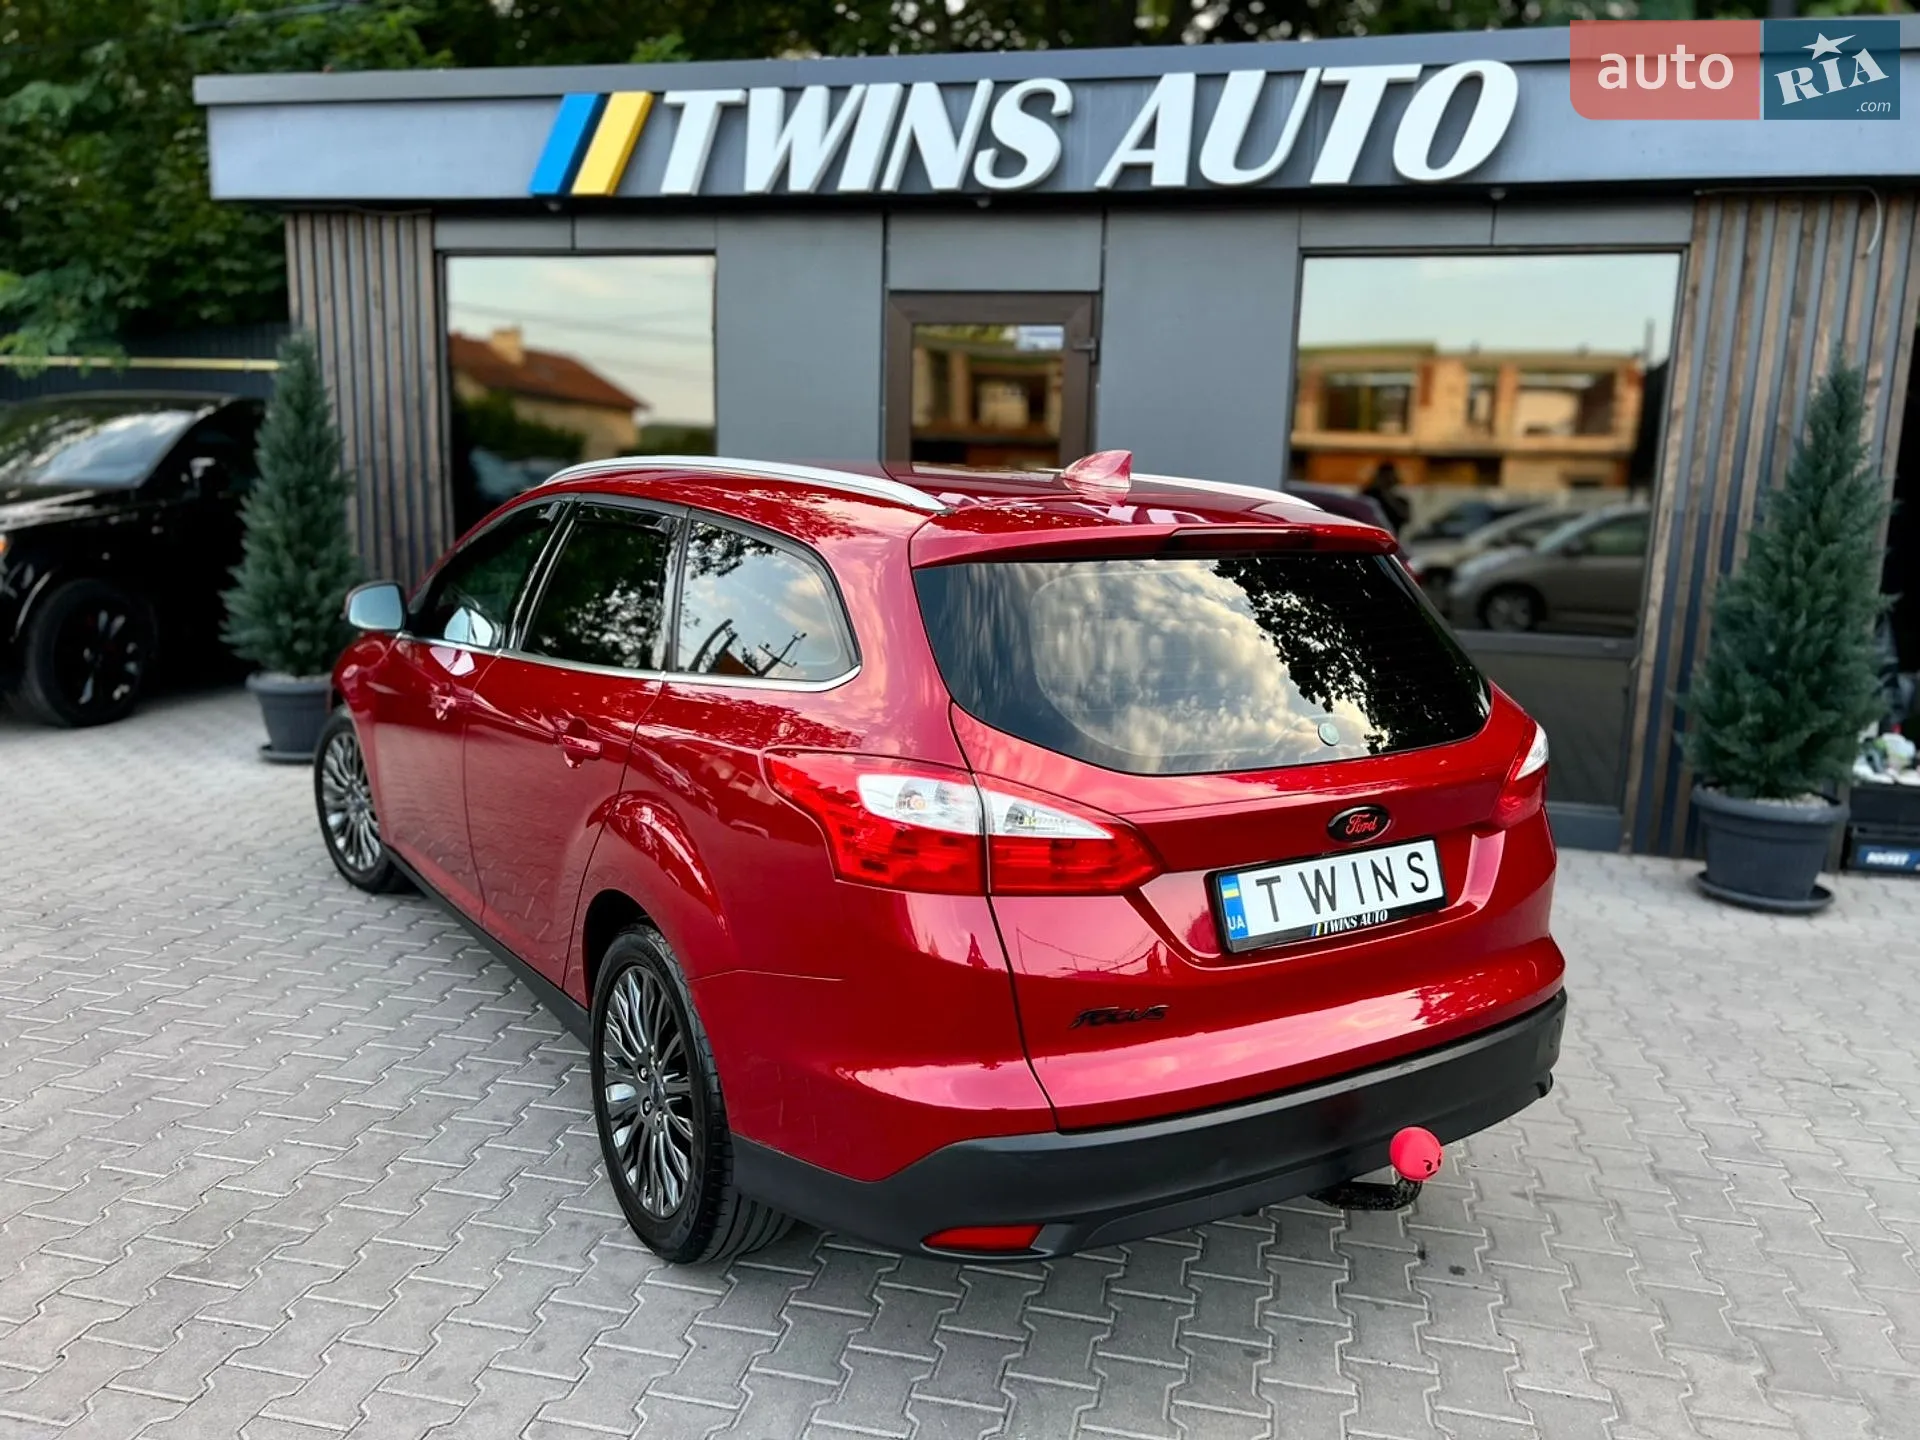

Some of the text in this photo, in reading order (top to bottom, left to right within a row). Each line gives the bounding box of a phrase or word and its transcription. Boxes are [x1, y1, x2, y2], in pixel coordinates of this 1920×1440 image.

[660, 60, 1519, 195] TWINS AUTO
[1346, 813, 1378, 835] Ford
[1255, 851, 1430, 923] TWINS
[1227, 914, 1247, 931] UA
[1323, 909, 1388, 935] TWINS AUTO
